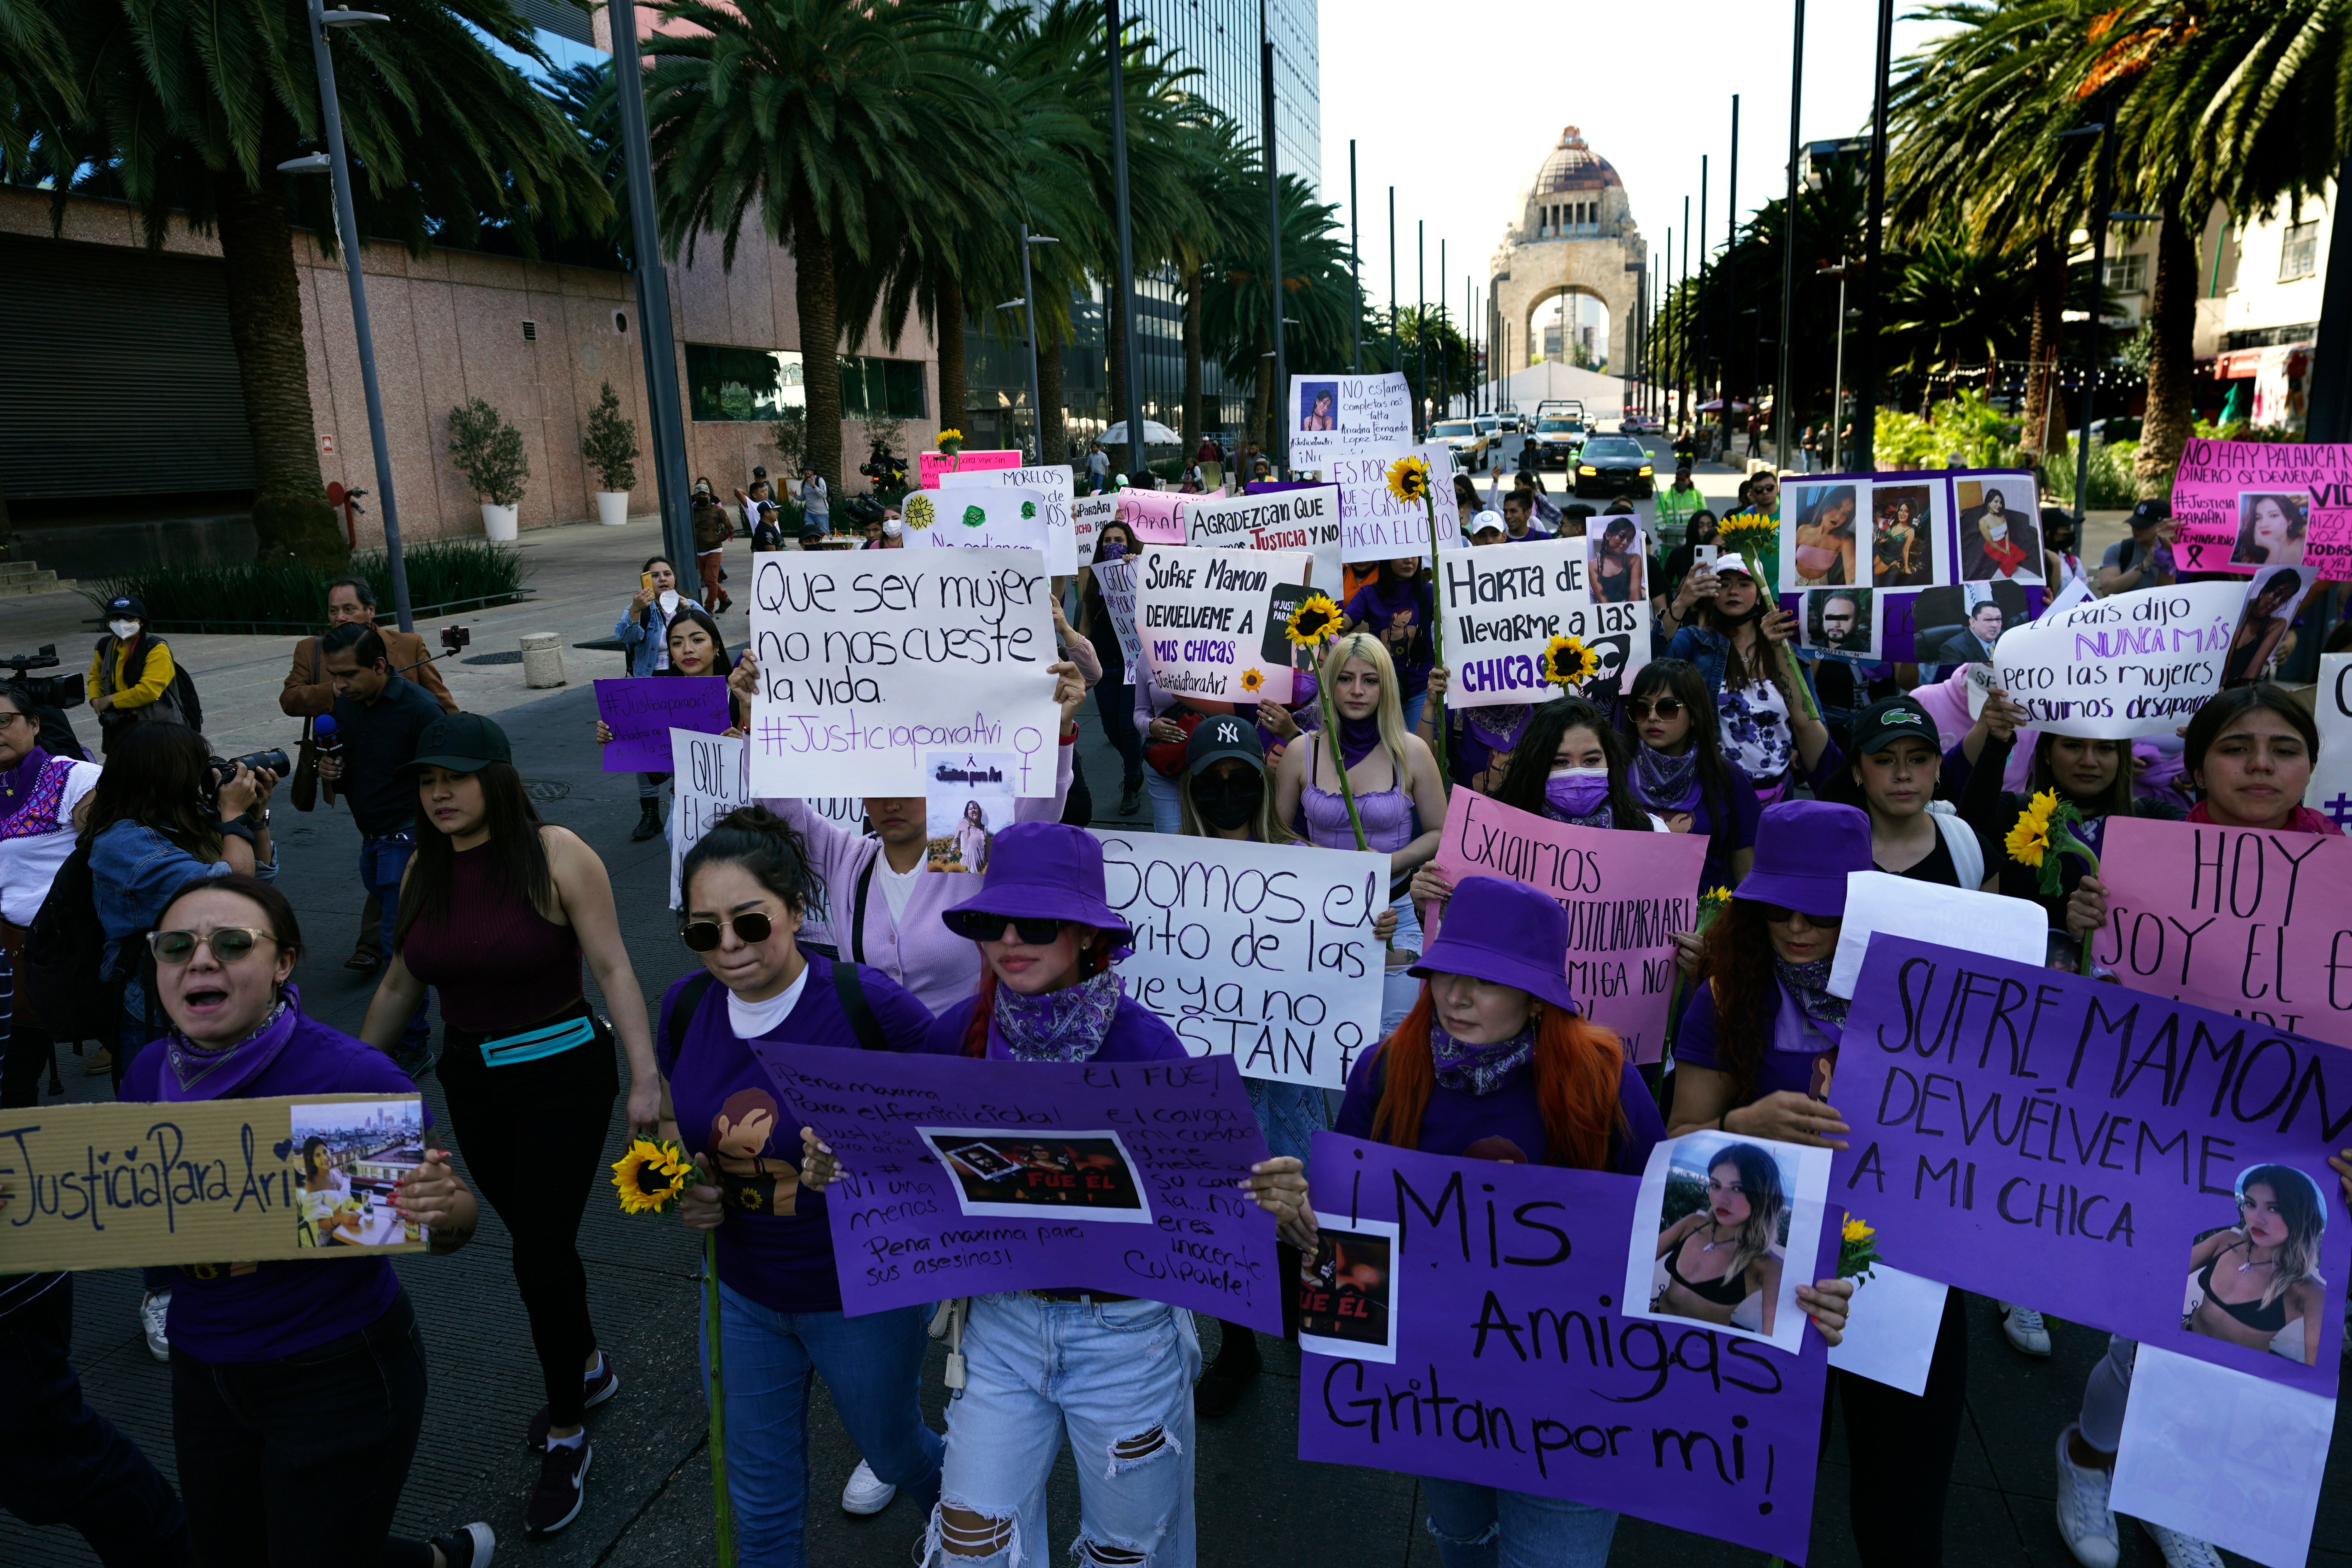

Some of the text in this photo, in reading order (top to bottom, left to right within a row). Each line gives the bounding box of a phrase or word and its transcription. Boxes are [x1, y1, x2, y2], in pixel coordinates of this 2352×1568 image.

[1343, 378, 1408, 398] NO estamos
[1343, 397, 1403, 414] completas nos
[1366, 411, 1389, 420] falta
[1340, 421, 1408, 434] Ariadna Fernanda
[959, 457, 976, 470] para
[2183, 442, 2212, 467] NO
[2218, 443, 2260, 468] HAY
[2264, 444, 2336, 469] PALANCA
[1003, 470, 1063, 487] MORELOS
[1334, 461, 1357, 484] ES
[1362, 459, 1386, 483] POR
[2178, 466, 2231, 483] DINERO
[1294, 497, 1324, 519] QUE
[2173, 490, 2235, 509] #JUSTICIA
[1309, 526, 1318, 545] Y
[1321, 524, 1339, 544] NO
[1341, 513, 1453, 548] HACIA EL CILO
[1078, 543, 1092, 555] POR
[757, 562, 1045, 627] Que ser mujer
[1273, 599, 1296, 612] #JUSTI
[1146, 604, 1234, 632] DEVUELVEME
[1237, 609, 1252, 634] A
[1568, 611, 1585, 636] a
[1596, 603, 1637, 634] las
[2067, 597, 2190, 628] país dijo
[758, 618, 1037, 665] no nos cueste
[1124, 638, 1141, 654] NO
[1153, 640, 1178, 663] MIS
[2076, 616, 2230, 661] NUNCA MÁS
[765, 665, 886, 705] la vida.
[2067, 665, 2108, 686] las
[2118, 661, 2213, 693] mujeres
[2013, 697, 2114, 722] seguimos
[758, 709, 1002, 769] #JusticiaparaAri
[691, 740, 729, 799] QUE
[1102, 838, 1376, 928] Somos el
[2190, 829, 2327, 926] HOY
[1231, 918, 1285, 972] de
[1308, 919, 1366, 979] las
[2100, 906, 2216, 985] SOY
[1568, 957, 1670, 997] MIGA NO
[1177, 975, 1327, 1027] ya no
[1877, 957, 2064, 1080] SUFRE
[1152, 1010, 1317, 1078] STÁN
[1877, 1066, 2236, 1197] DEVUÉLVEME
[1026, 1171, 1116, 1190] FUE ÉL
[1847, 1141, 2134, 1248] A MI CHICA
[862, 1235, 931, 1263] Pena
[866, 1265, 901, 1287] sus
[1299, 1290, 1368, 1318] UE ÉL
[1470, 1289, 1784, 1404] Amigas
[1322, 1357, 1527, 1458] Gritan
[1531, 1413, 1634, 1479] por
